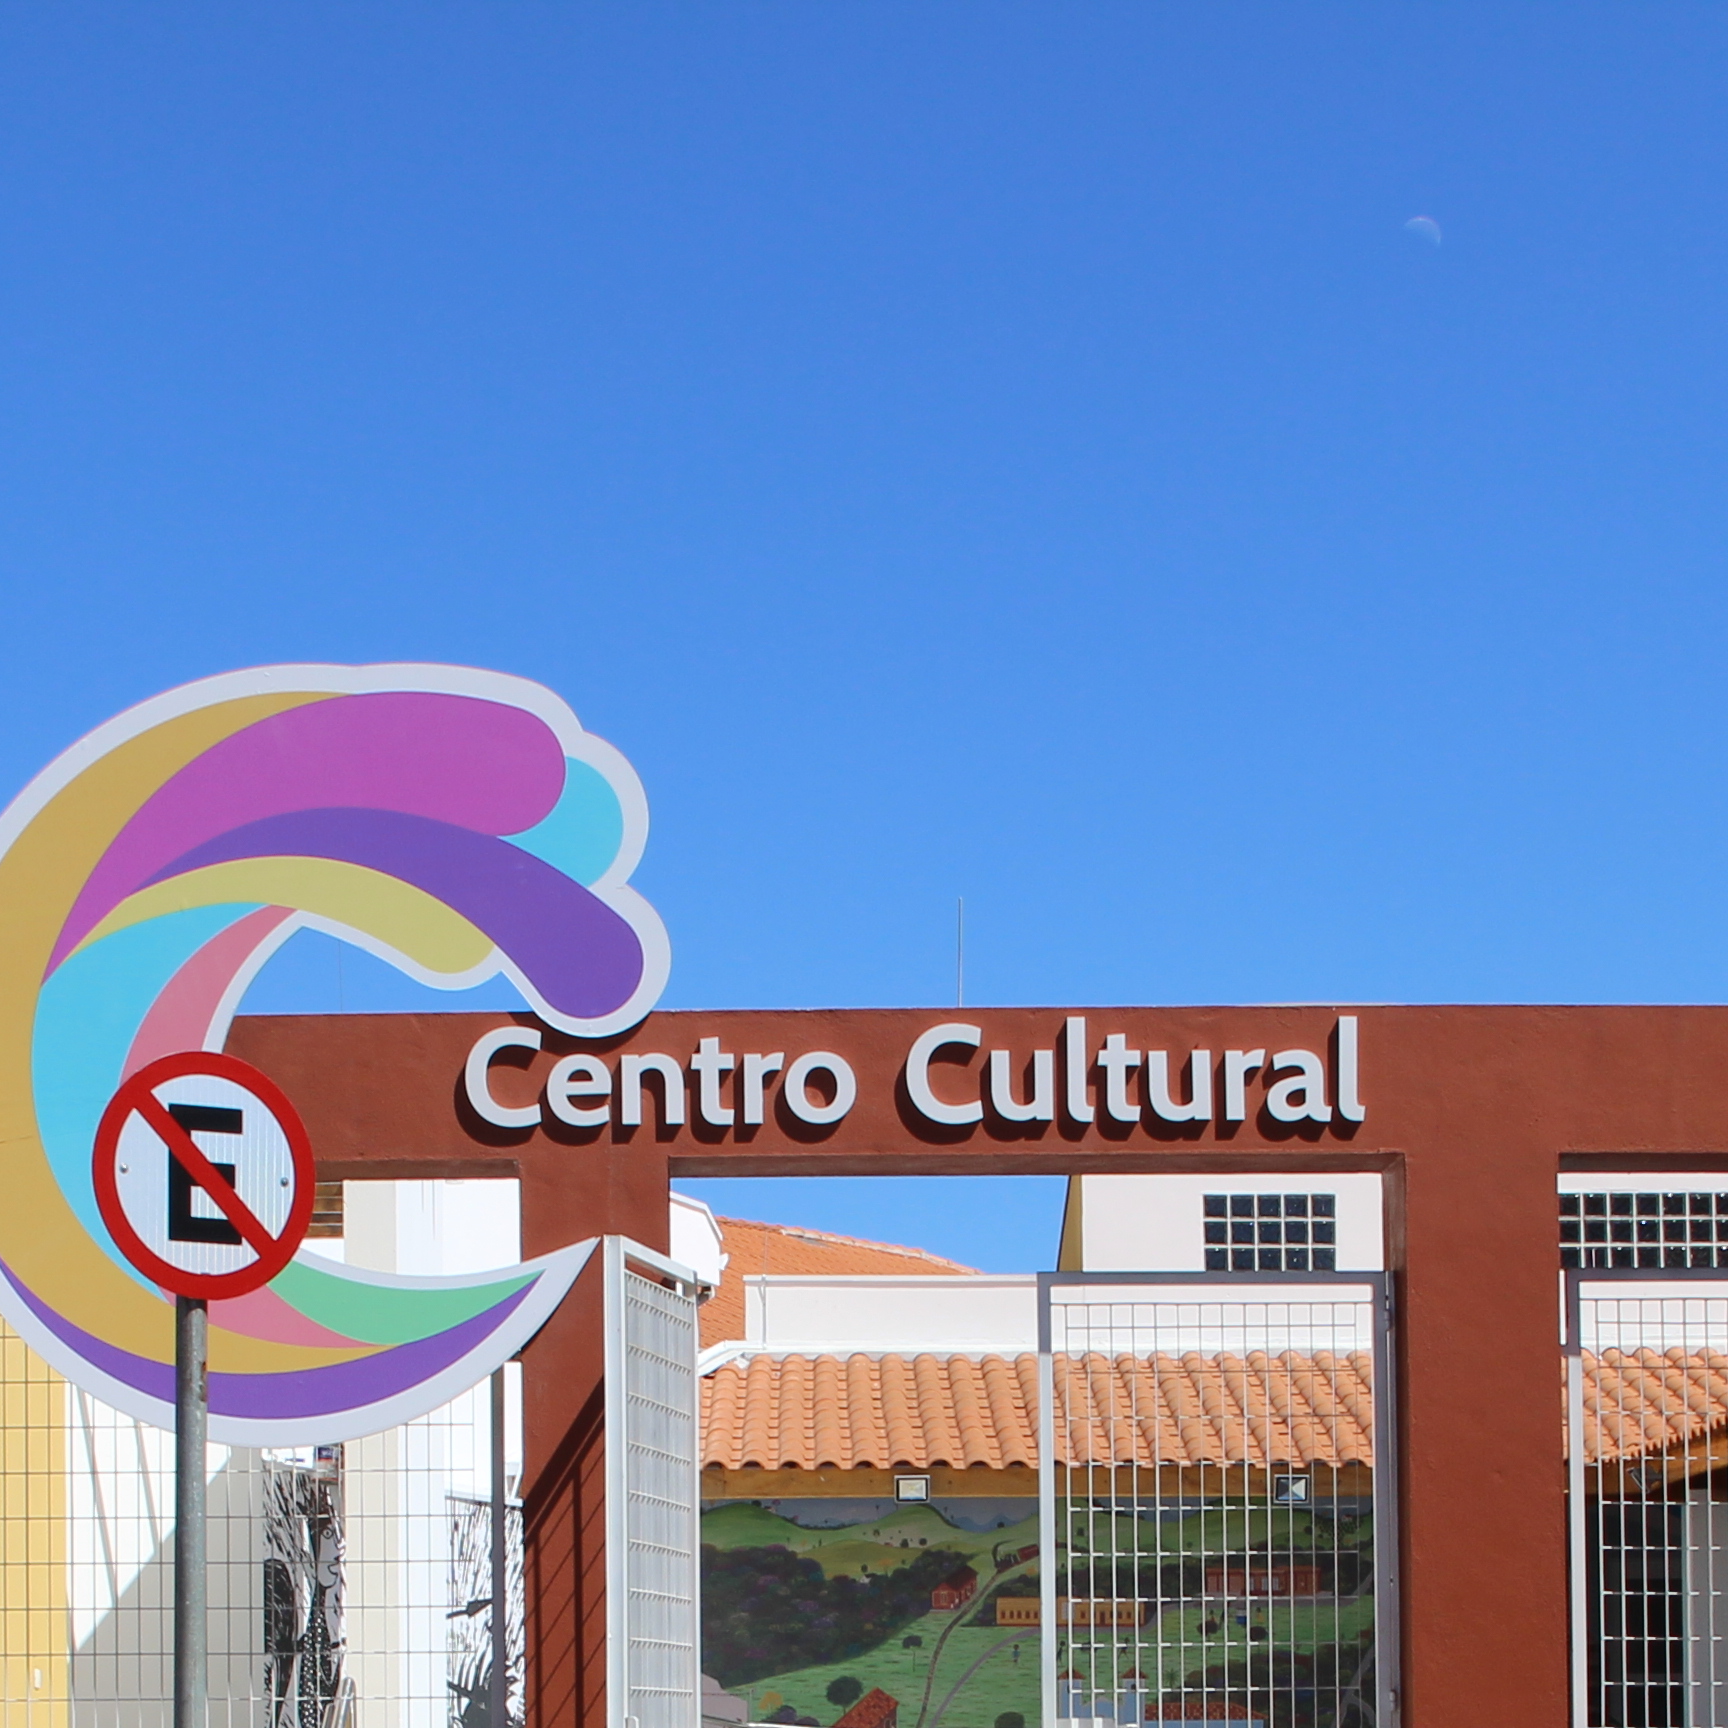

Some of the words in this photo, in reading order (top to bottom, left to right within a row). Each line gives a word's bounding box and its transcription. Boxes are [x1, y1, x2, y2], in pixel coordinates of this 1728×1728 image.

[464, 1026, 857, 1129] Centro
[905, 1015, 1366, 1127] Cultural
[168, 1103, 243, 1246] E
